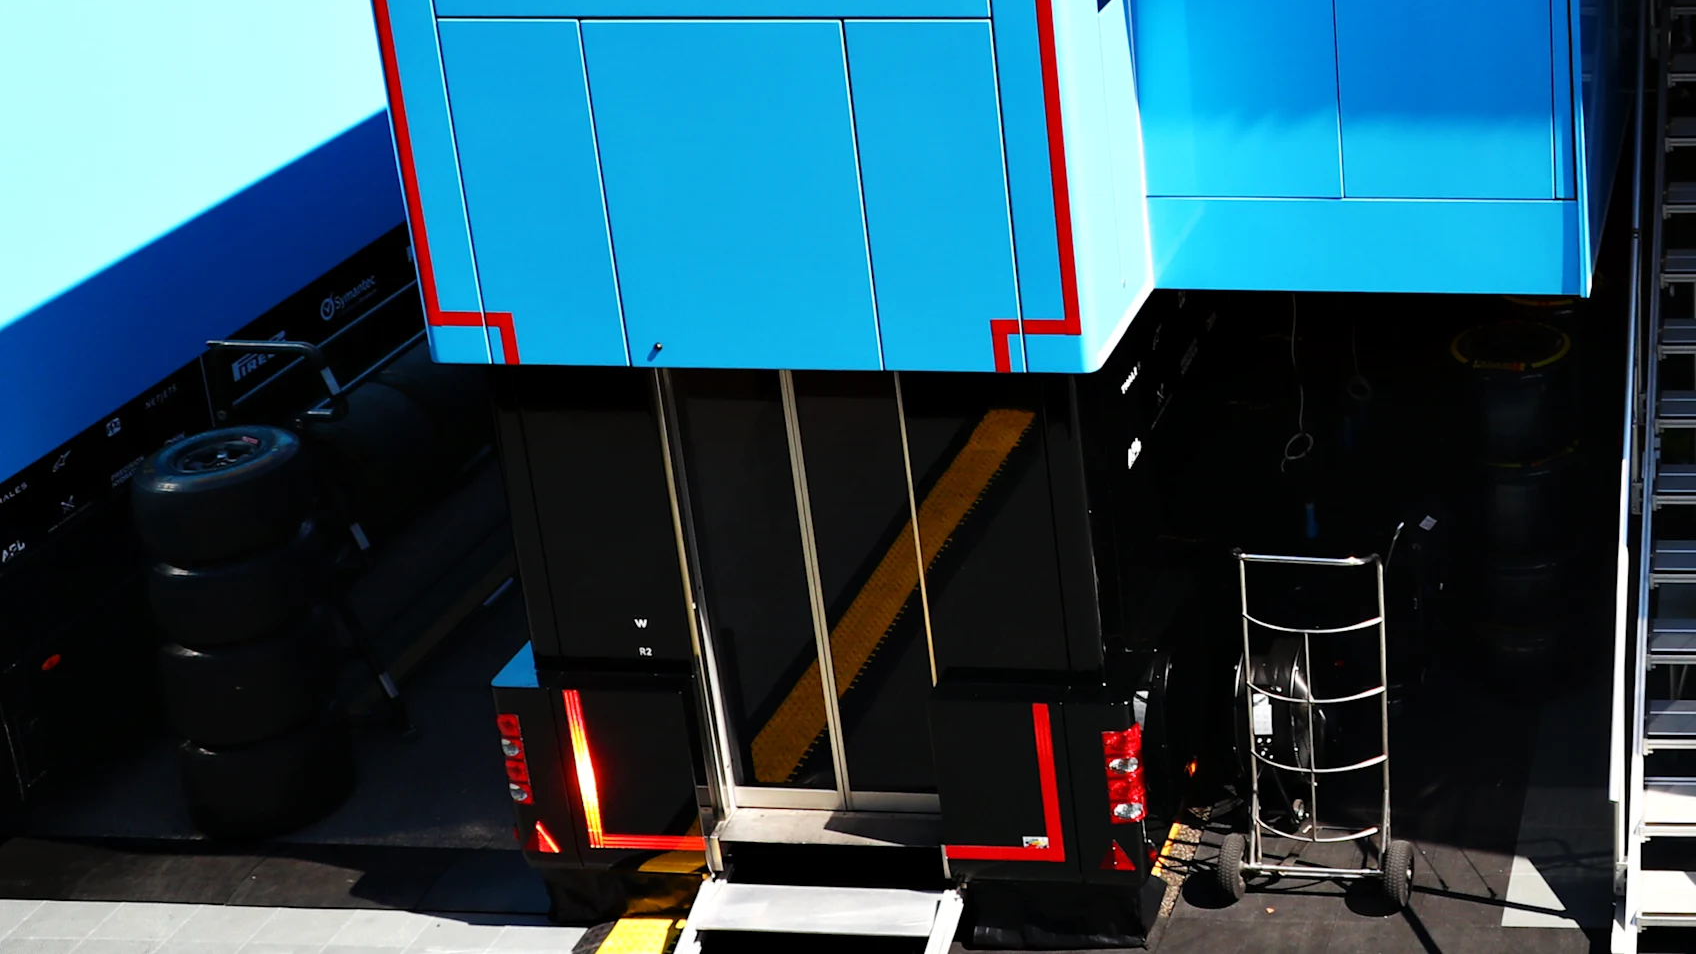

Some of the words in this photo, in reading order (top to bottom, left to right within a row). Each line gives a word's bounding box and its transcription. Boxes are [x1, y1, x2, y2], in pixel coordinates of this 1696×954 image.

[333, 273, 377, 312] Symantec
[634, 618, 649, 629] W
[638, 646, 653, 657] R2
